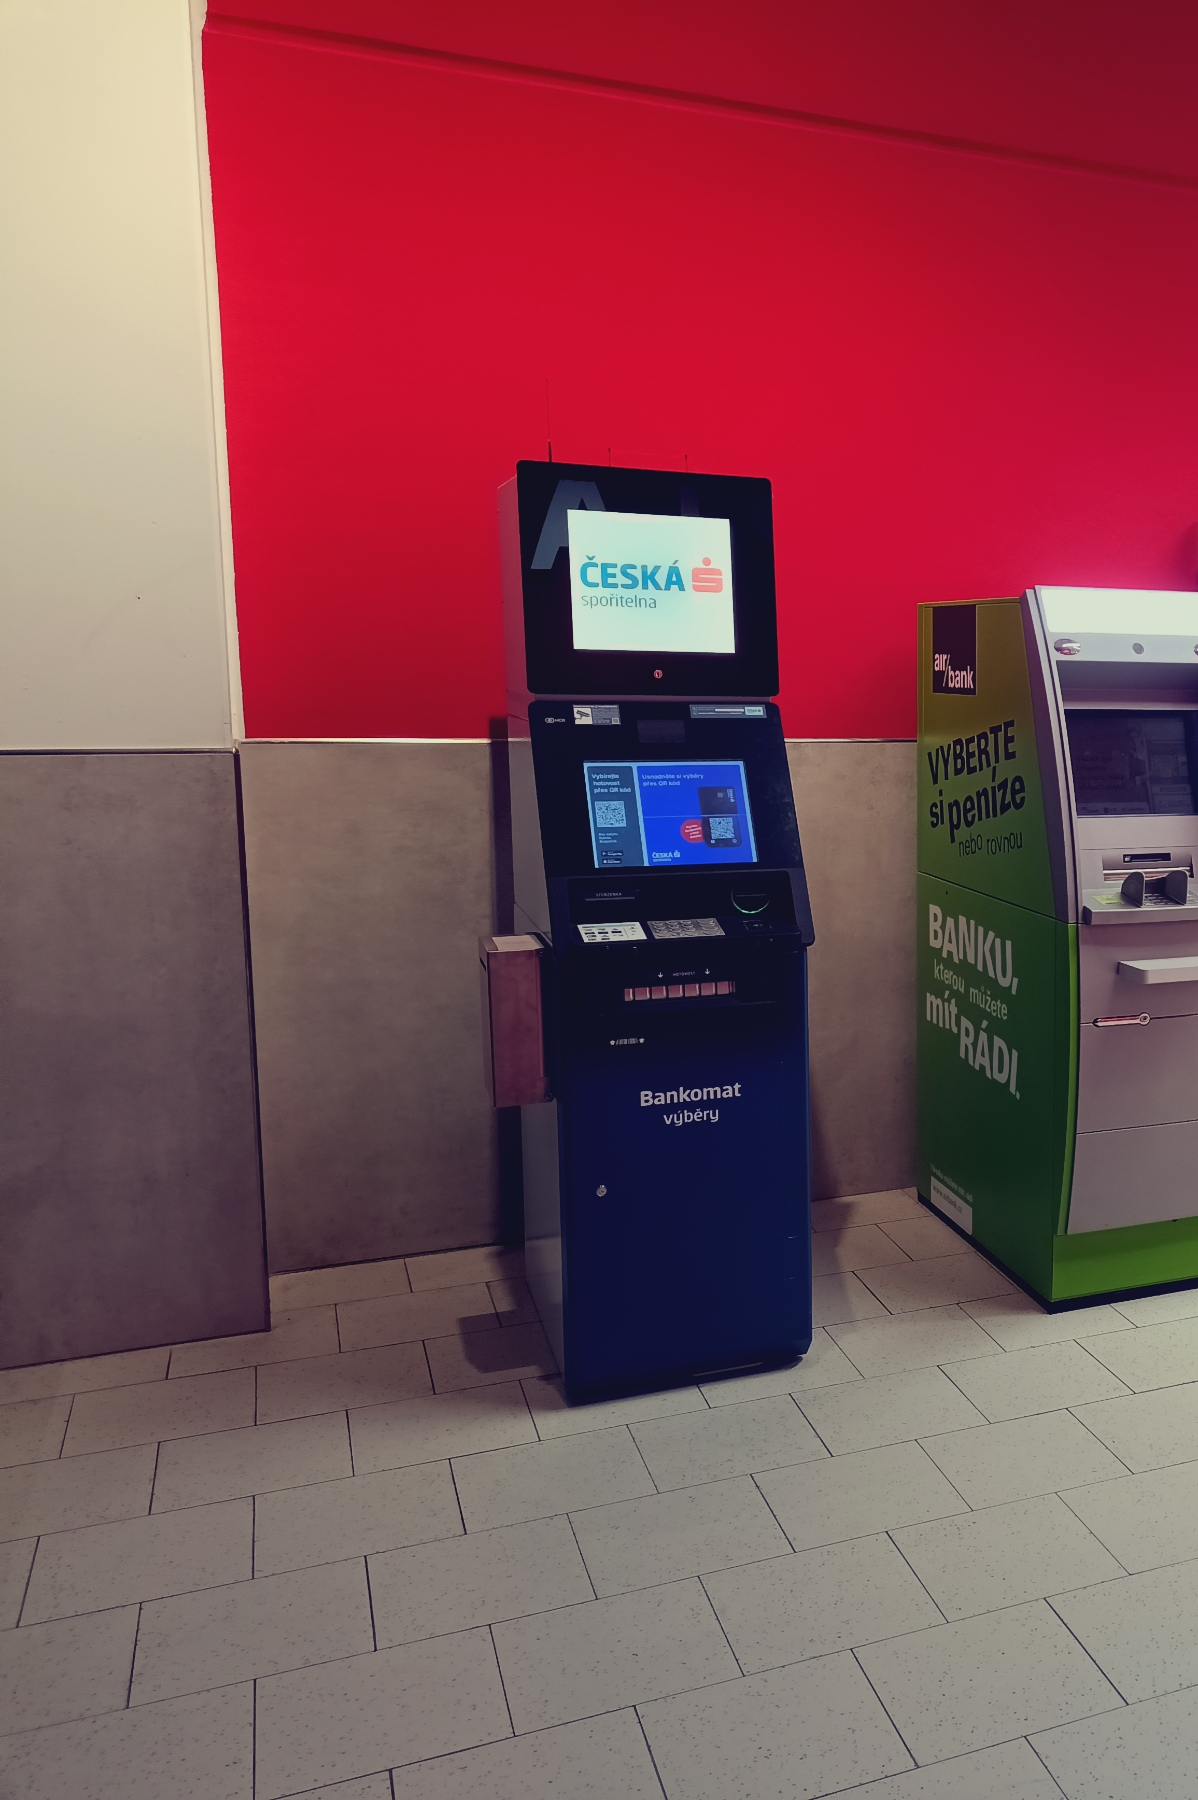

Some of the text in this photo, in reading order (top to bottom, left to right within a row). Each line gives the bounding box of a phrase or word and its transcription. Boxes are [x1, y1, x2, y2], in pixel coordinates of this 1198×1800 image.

[580, 555, 685, 591] ČESKÁ
[581, 592, 657, 609] spořitelna
[948, 665, 974, 689] bank
[927, 719, 1017, 785] VYBERTE
[929, 789, 945, 829] si
[947, 765, 1026, 844] peníze
[958, 831, 1023, 858] nebo rovnou
[928, 903, 1019, 996] BANKU,
[933, 958, 1008, 1021] kterou můžete
[926, 990, 1021, 1101] mít RÁDI.
[640, 1083, 742, 1107] Bankomat
[663, 1107, 720, 1127] výběry
